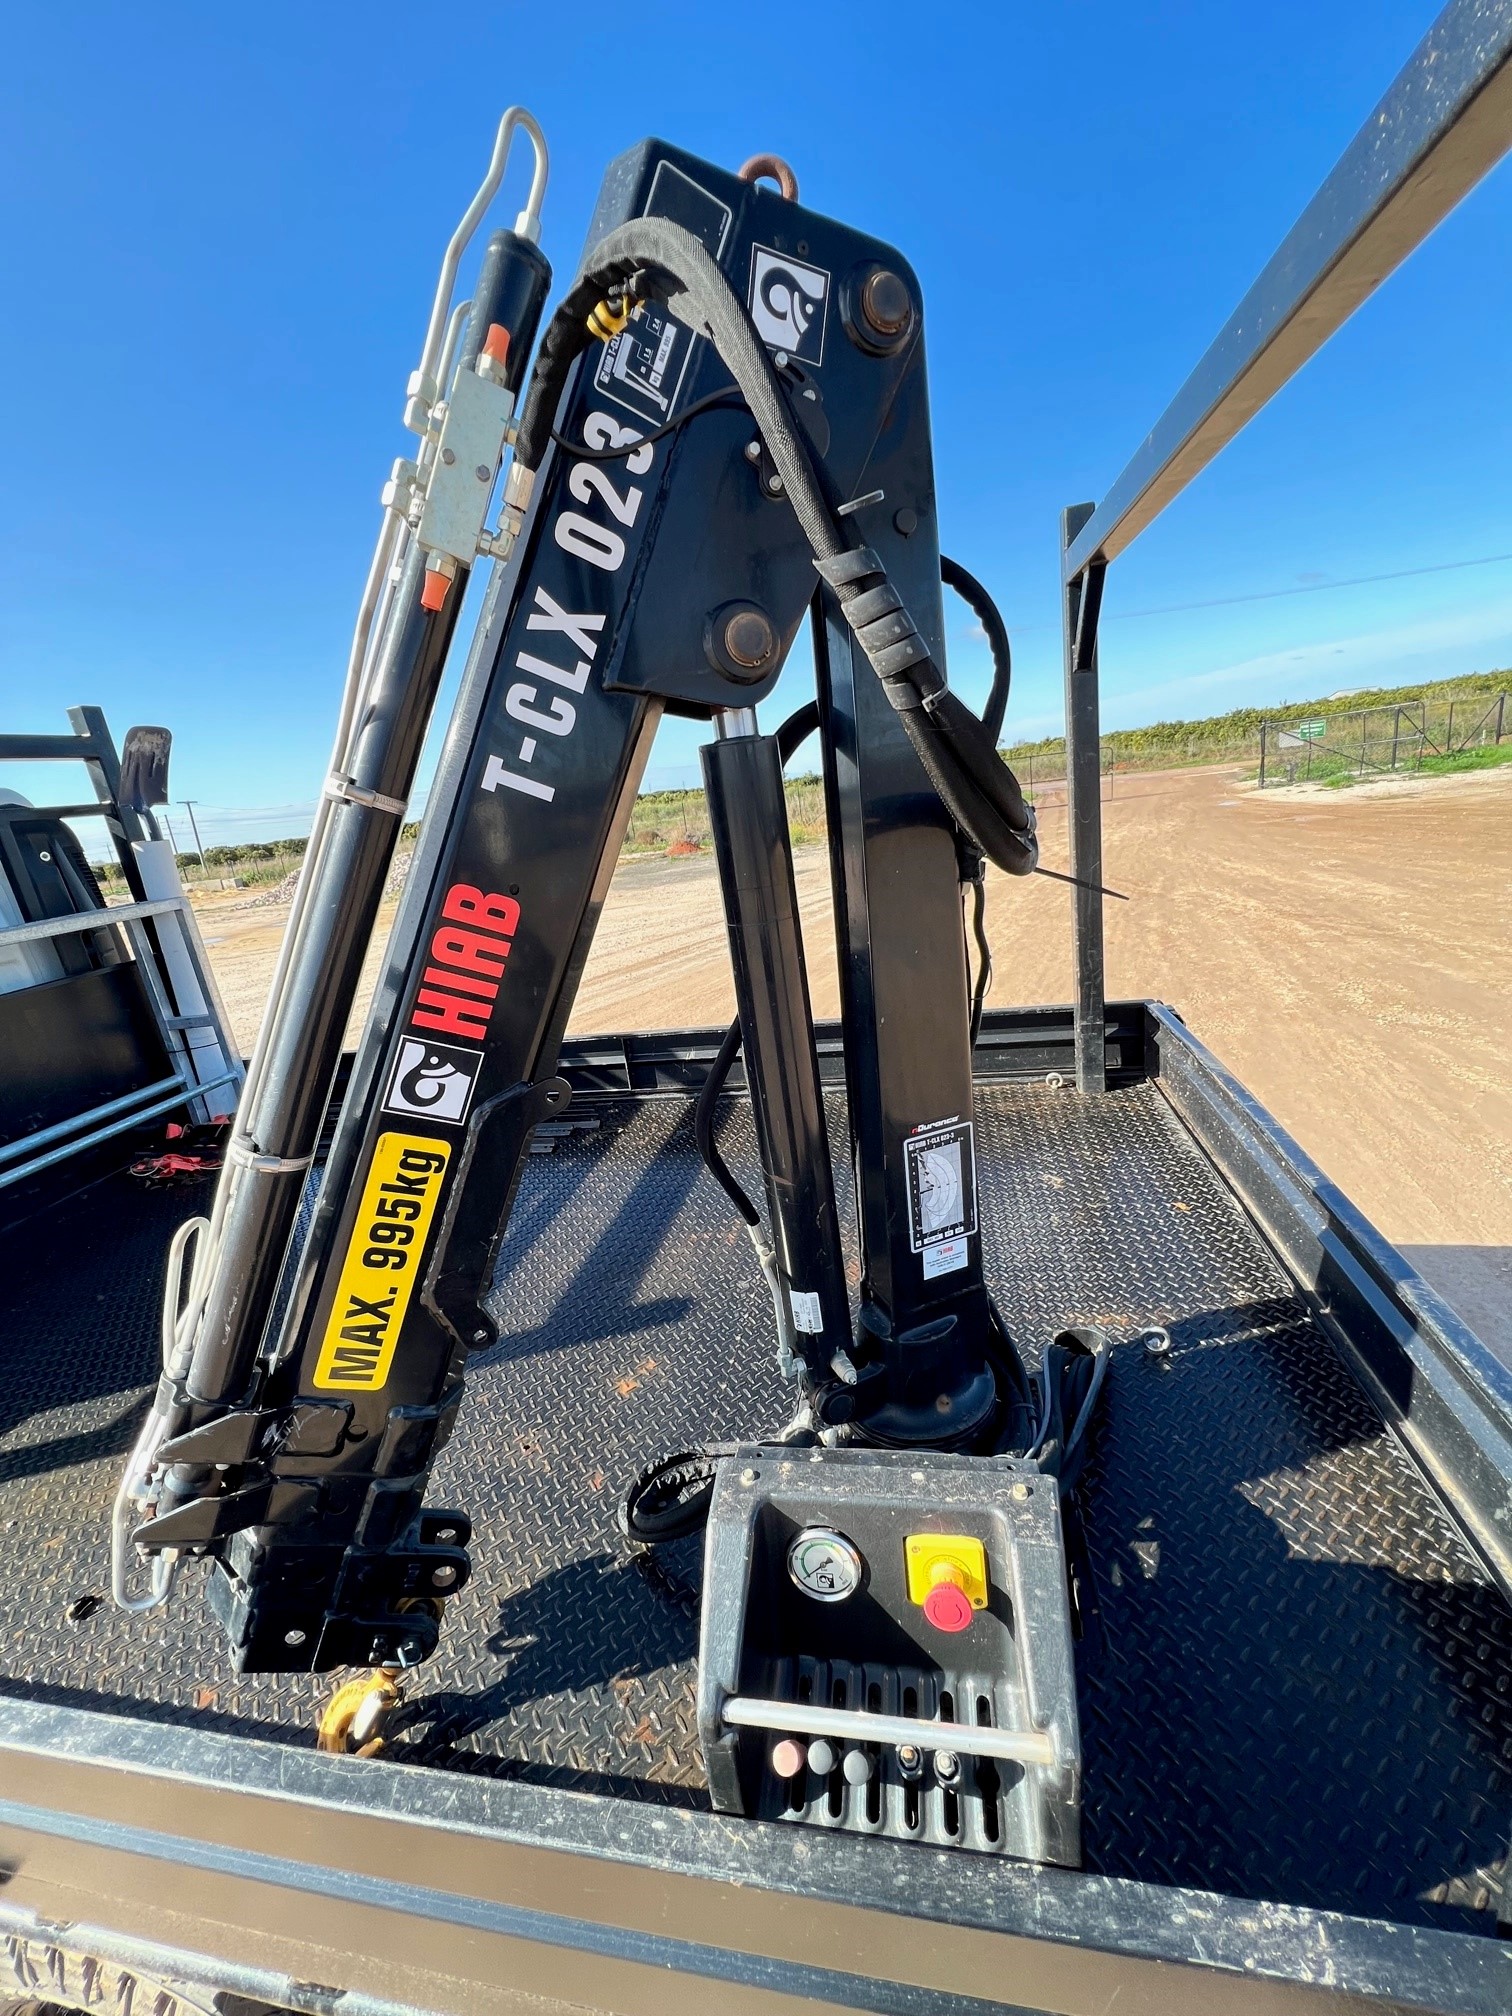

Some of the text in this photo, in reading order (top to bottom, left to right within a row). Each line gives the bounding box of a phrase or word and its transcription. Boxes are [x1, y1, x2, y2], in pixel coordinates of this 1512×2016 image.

[481, 411, 654, 803] T-CLX 023
[412, 883, 521, 1040] HIAB
[328, 1148, 446, 1382] MAX. 995kg
